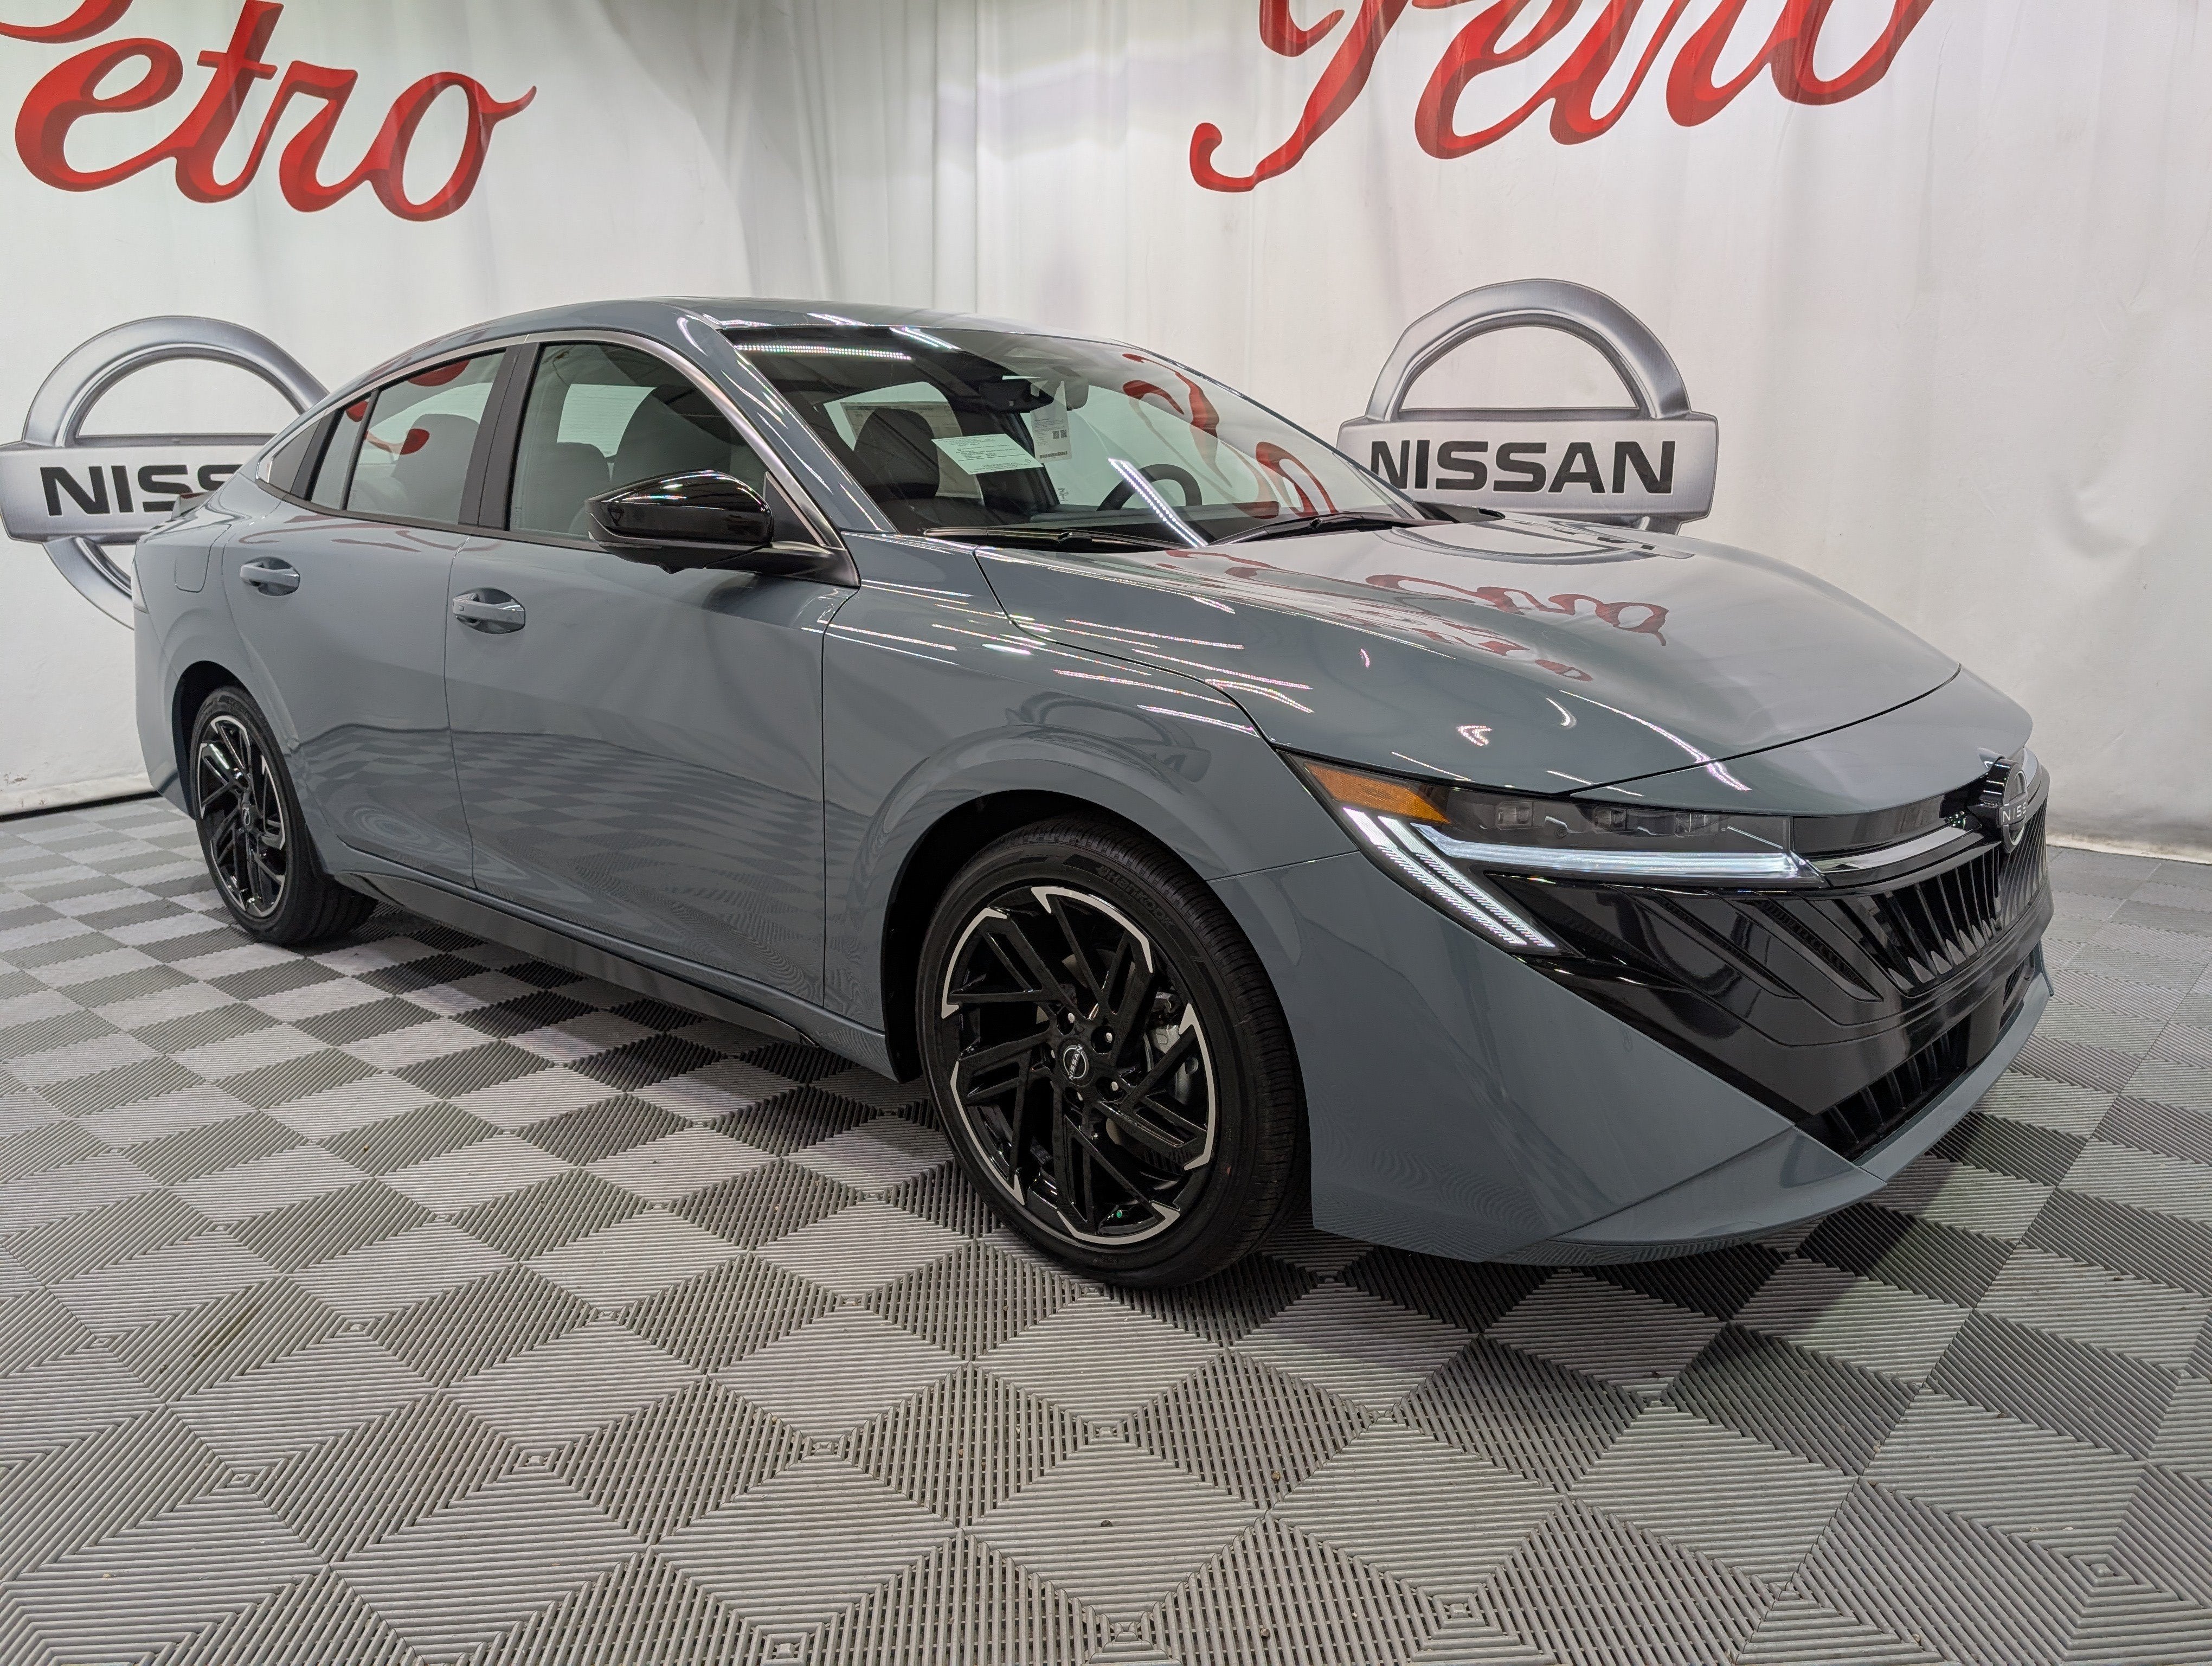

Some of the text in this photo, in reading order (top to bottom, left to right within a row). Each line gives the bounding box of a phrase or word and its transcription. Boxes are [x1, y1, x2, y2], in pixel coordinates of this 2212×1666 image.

[0, 0, 537, 222] etro
[1371, 440, 1675, 494] NISSAN
[1069, 1045, 1083, 1080] NISSAN
